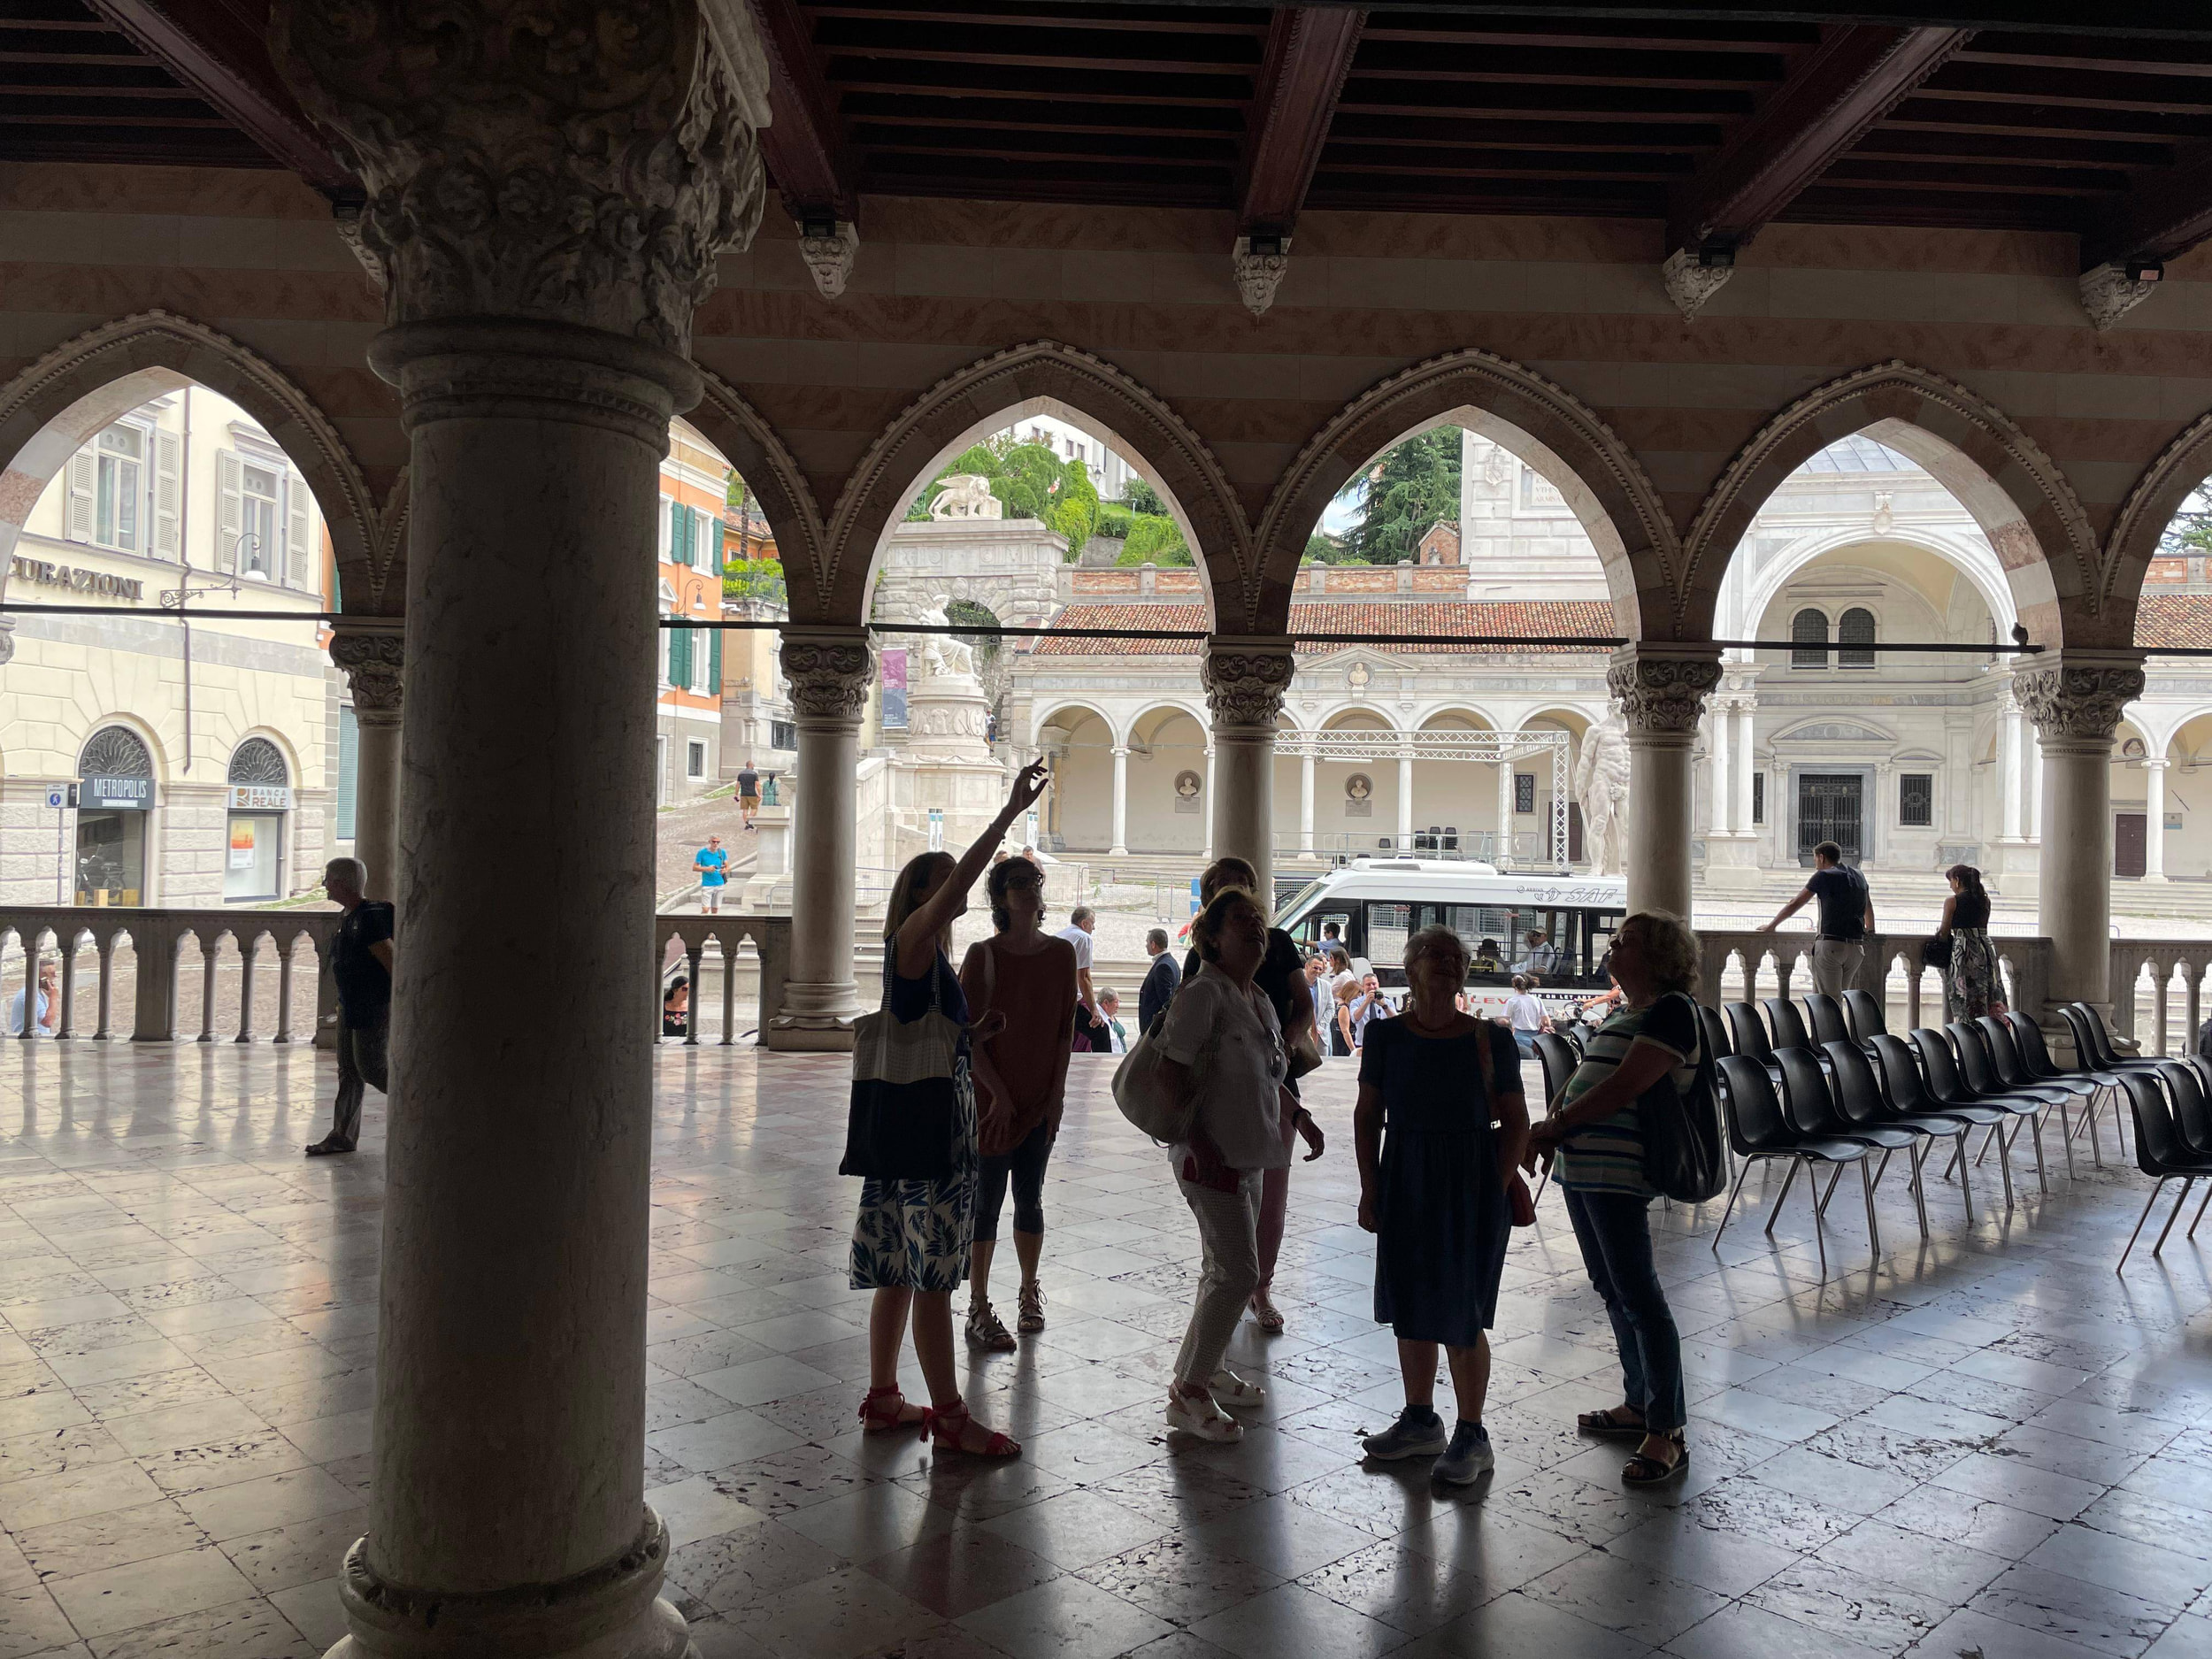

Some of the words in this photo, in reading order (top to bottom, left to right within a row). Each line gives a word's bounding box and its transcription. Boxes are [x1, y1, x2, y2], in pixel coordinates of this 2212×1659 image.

[93, 778, 147, 798] METROPOLIS
[252, 796, 287, 807] REALE
[1565, 887, 1617, 903] SAF
